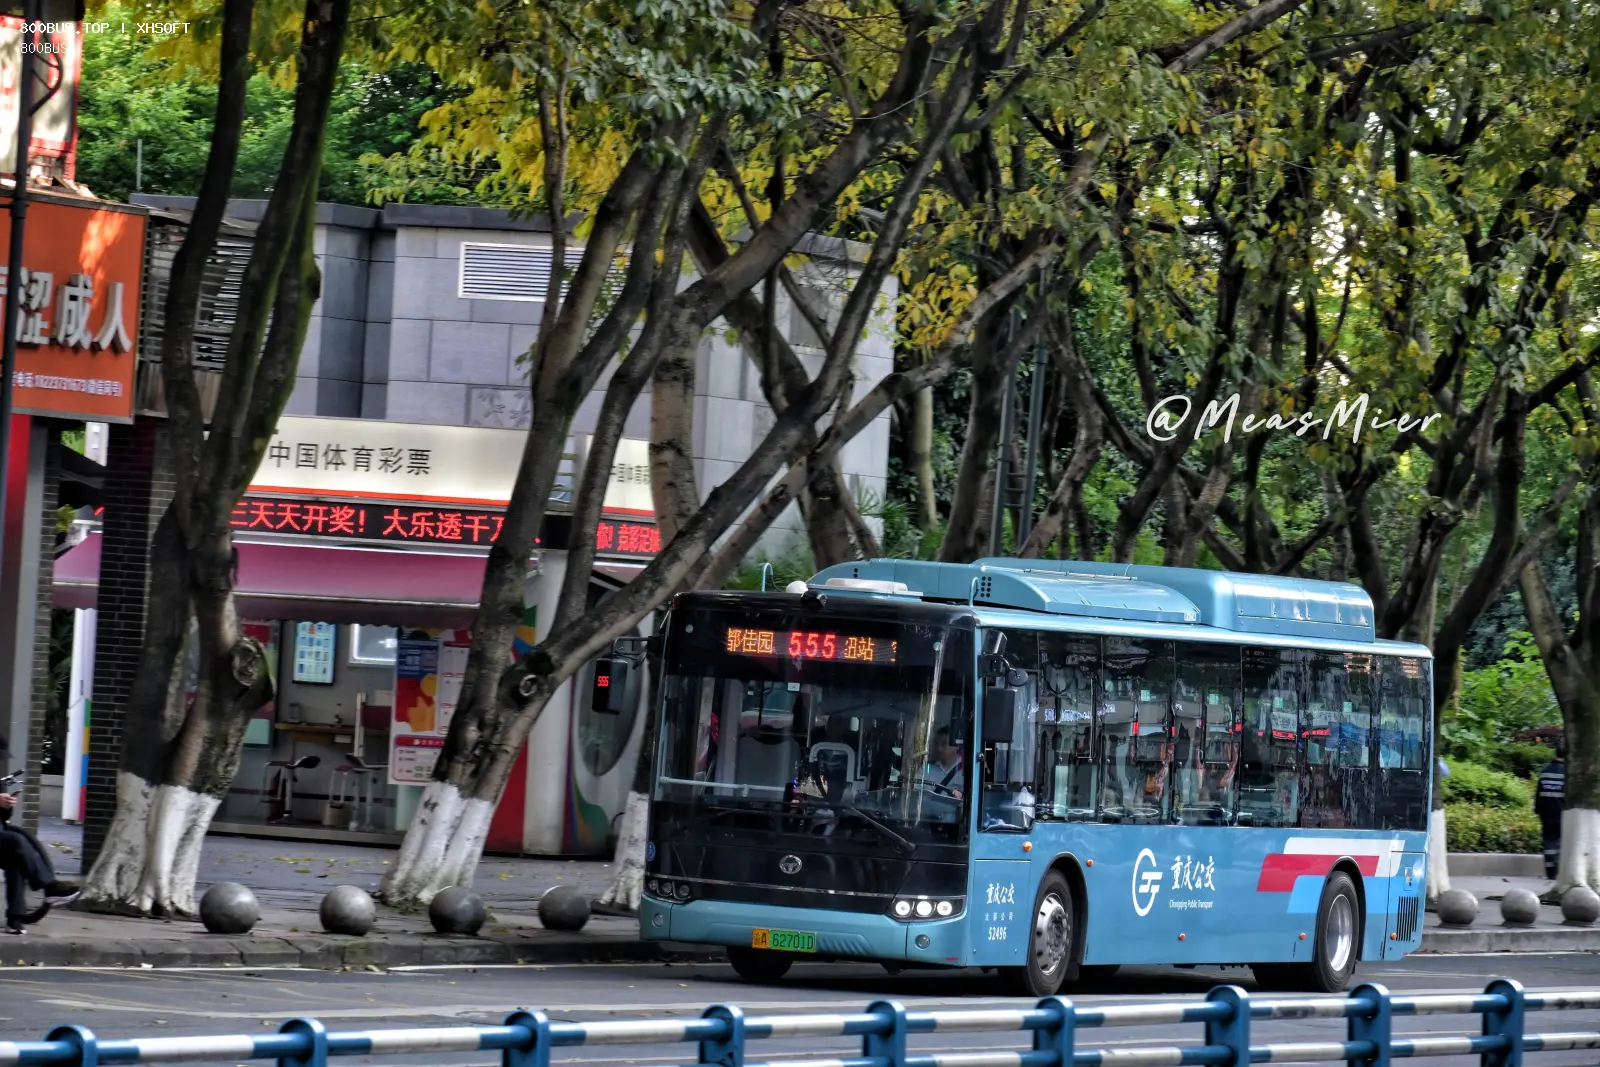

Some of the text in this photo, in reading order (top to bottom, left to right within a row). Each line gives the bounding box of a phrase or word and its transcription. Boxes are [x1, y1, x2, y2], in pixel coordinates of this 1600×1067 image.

[269, 440, 432, 476] 中国体育彩票
[789, 632, 835, 659] 555
